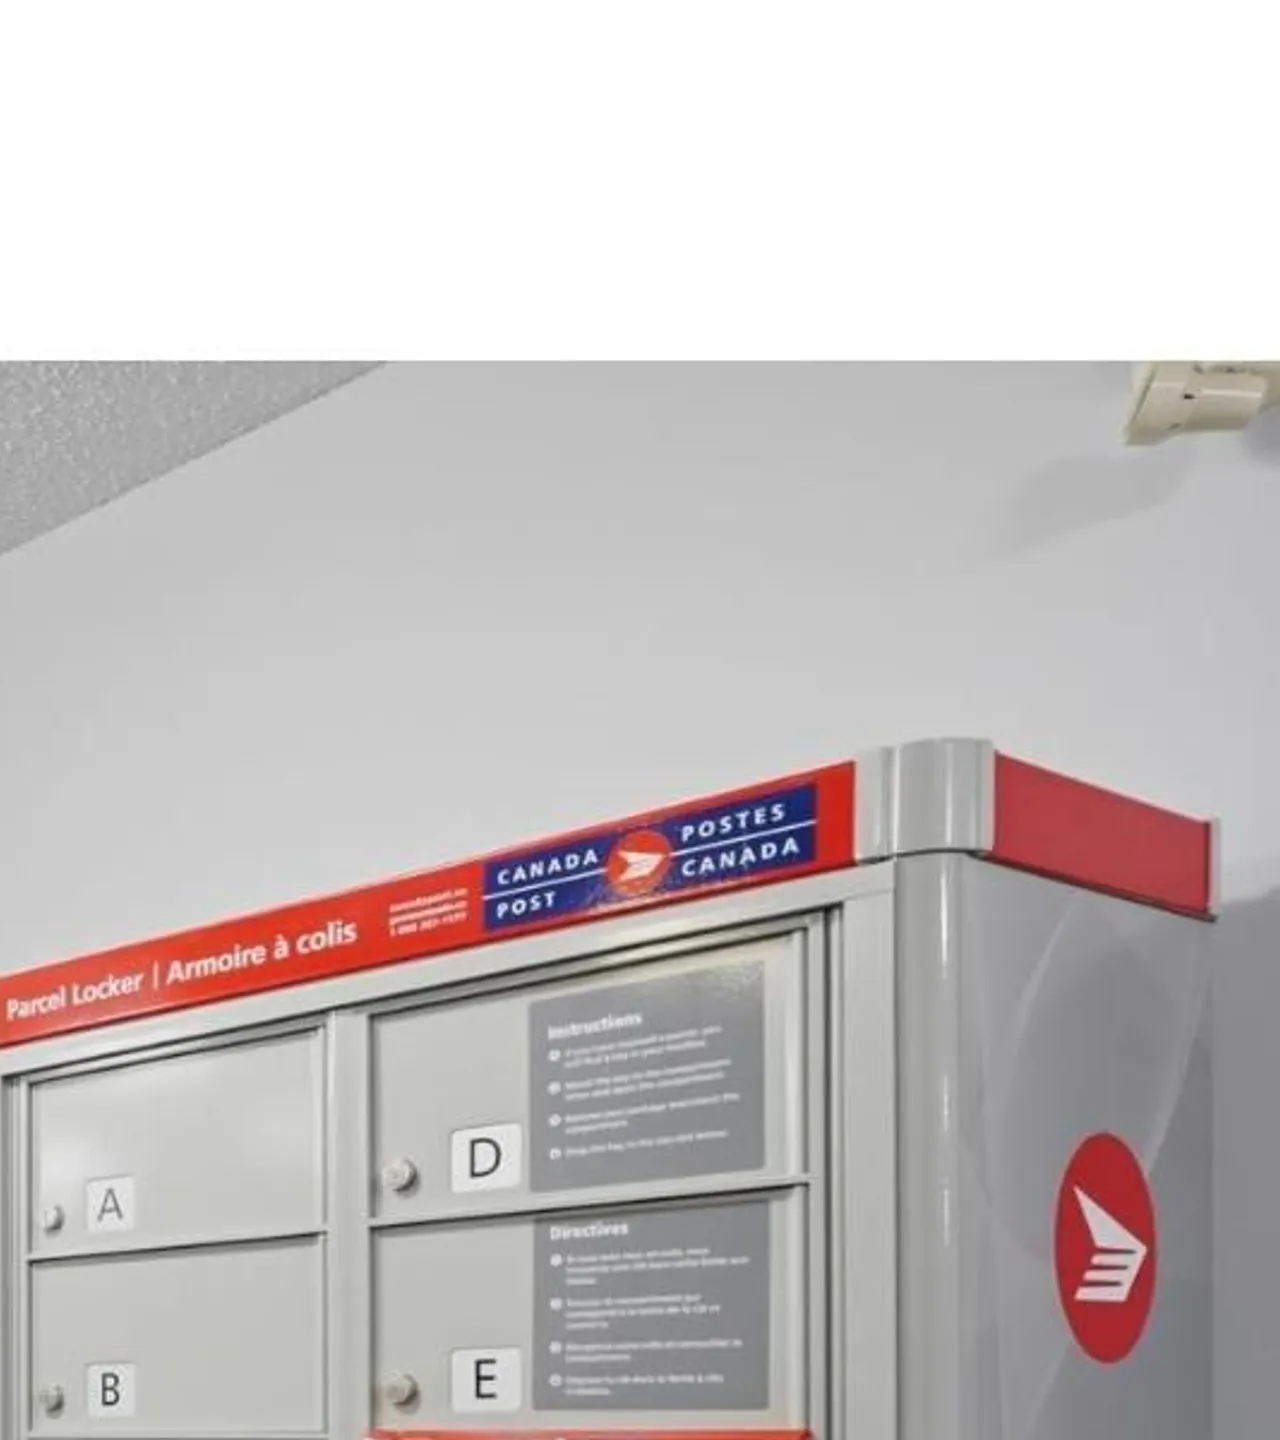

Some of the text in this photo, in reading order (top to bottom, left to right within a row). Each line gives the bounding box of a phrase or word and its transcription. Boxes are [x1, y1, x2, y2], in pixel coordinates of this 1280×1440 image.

[681, 803, 785, 842] POSTES
[496, 849, 598, 885] CANADA
[681, 837, 800, 877] CANADA
[496, 890, 557, 919] POST
[7, 986, 65, 1020] Parcel
[72, 972, 144, 1005] Locker
[166, 946, 267, 984] Armoire
[273, 934, 290, 960] à
[296, 920, 358, 953] colis
[548, 1012, 643, 1041] Instructions
[469, 1137, 502, 1178] D
[97, 1187, 124, 1222] A
[549, 1220, 629, 1241] Directives
[100, 1371, 122, 1405] B
[474, 1358, 498, 1399] E
